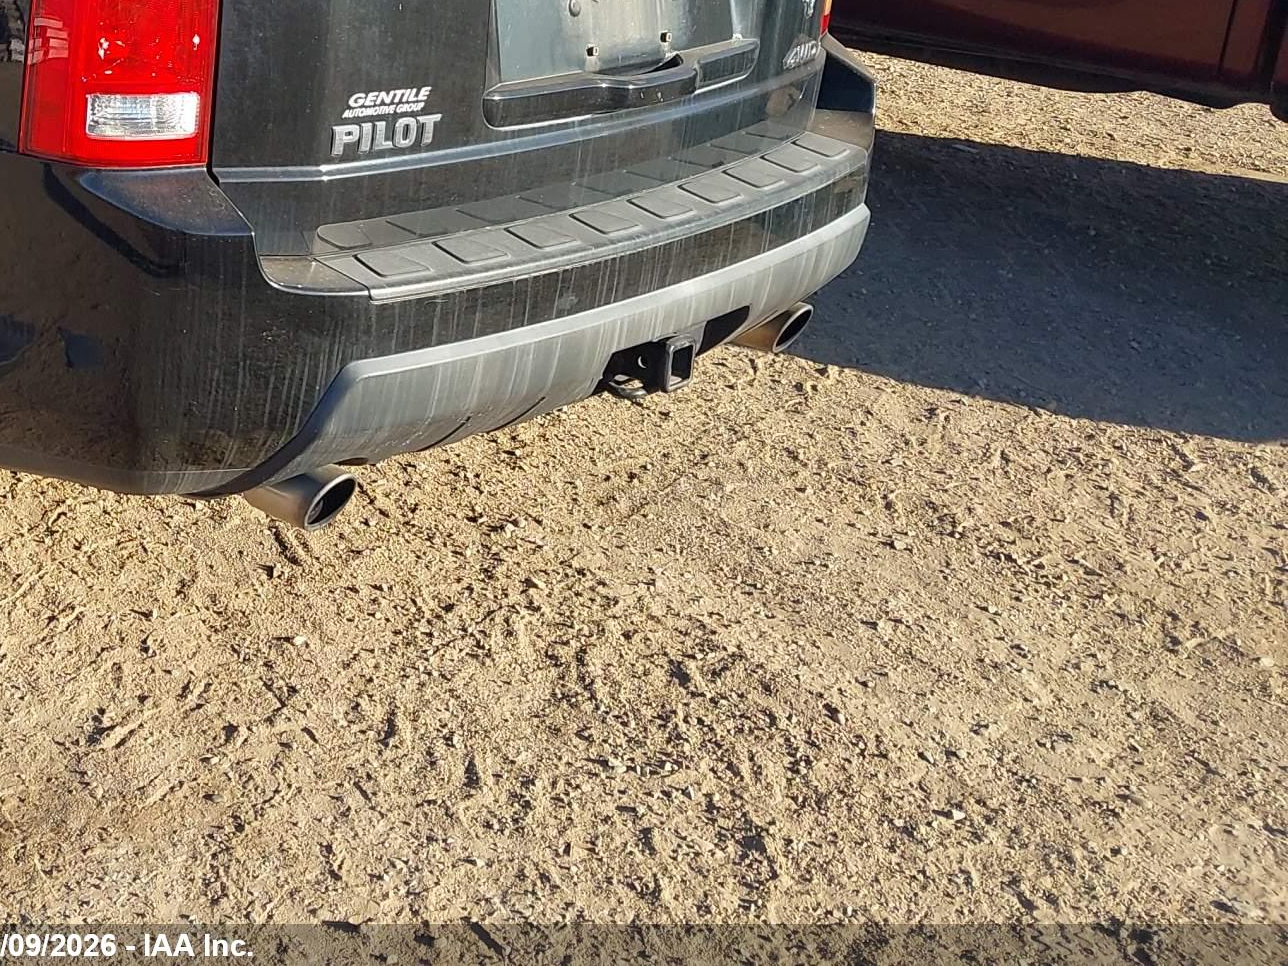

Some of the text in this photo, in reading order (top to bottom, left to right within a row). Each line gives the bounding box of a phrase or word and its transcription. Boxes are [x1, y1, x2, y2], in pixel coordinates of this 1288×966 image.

[782, 40, 817, 70] 4WD
[342, 101, 425, 119] AUTOMOTIVE GROUP
[348, 86, 432, 108] GENTILE
[330, 113, 443, 157] PILOT
